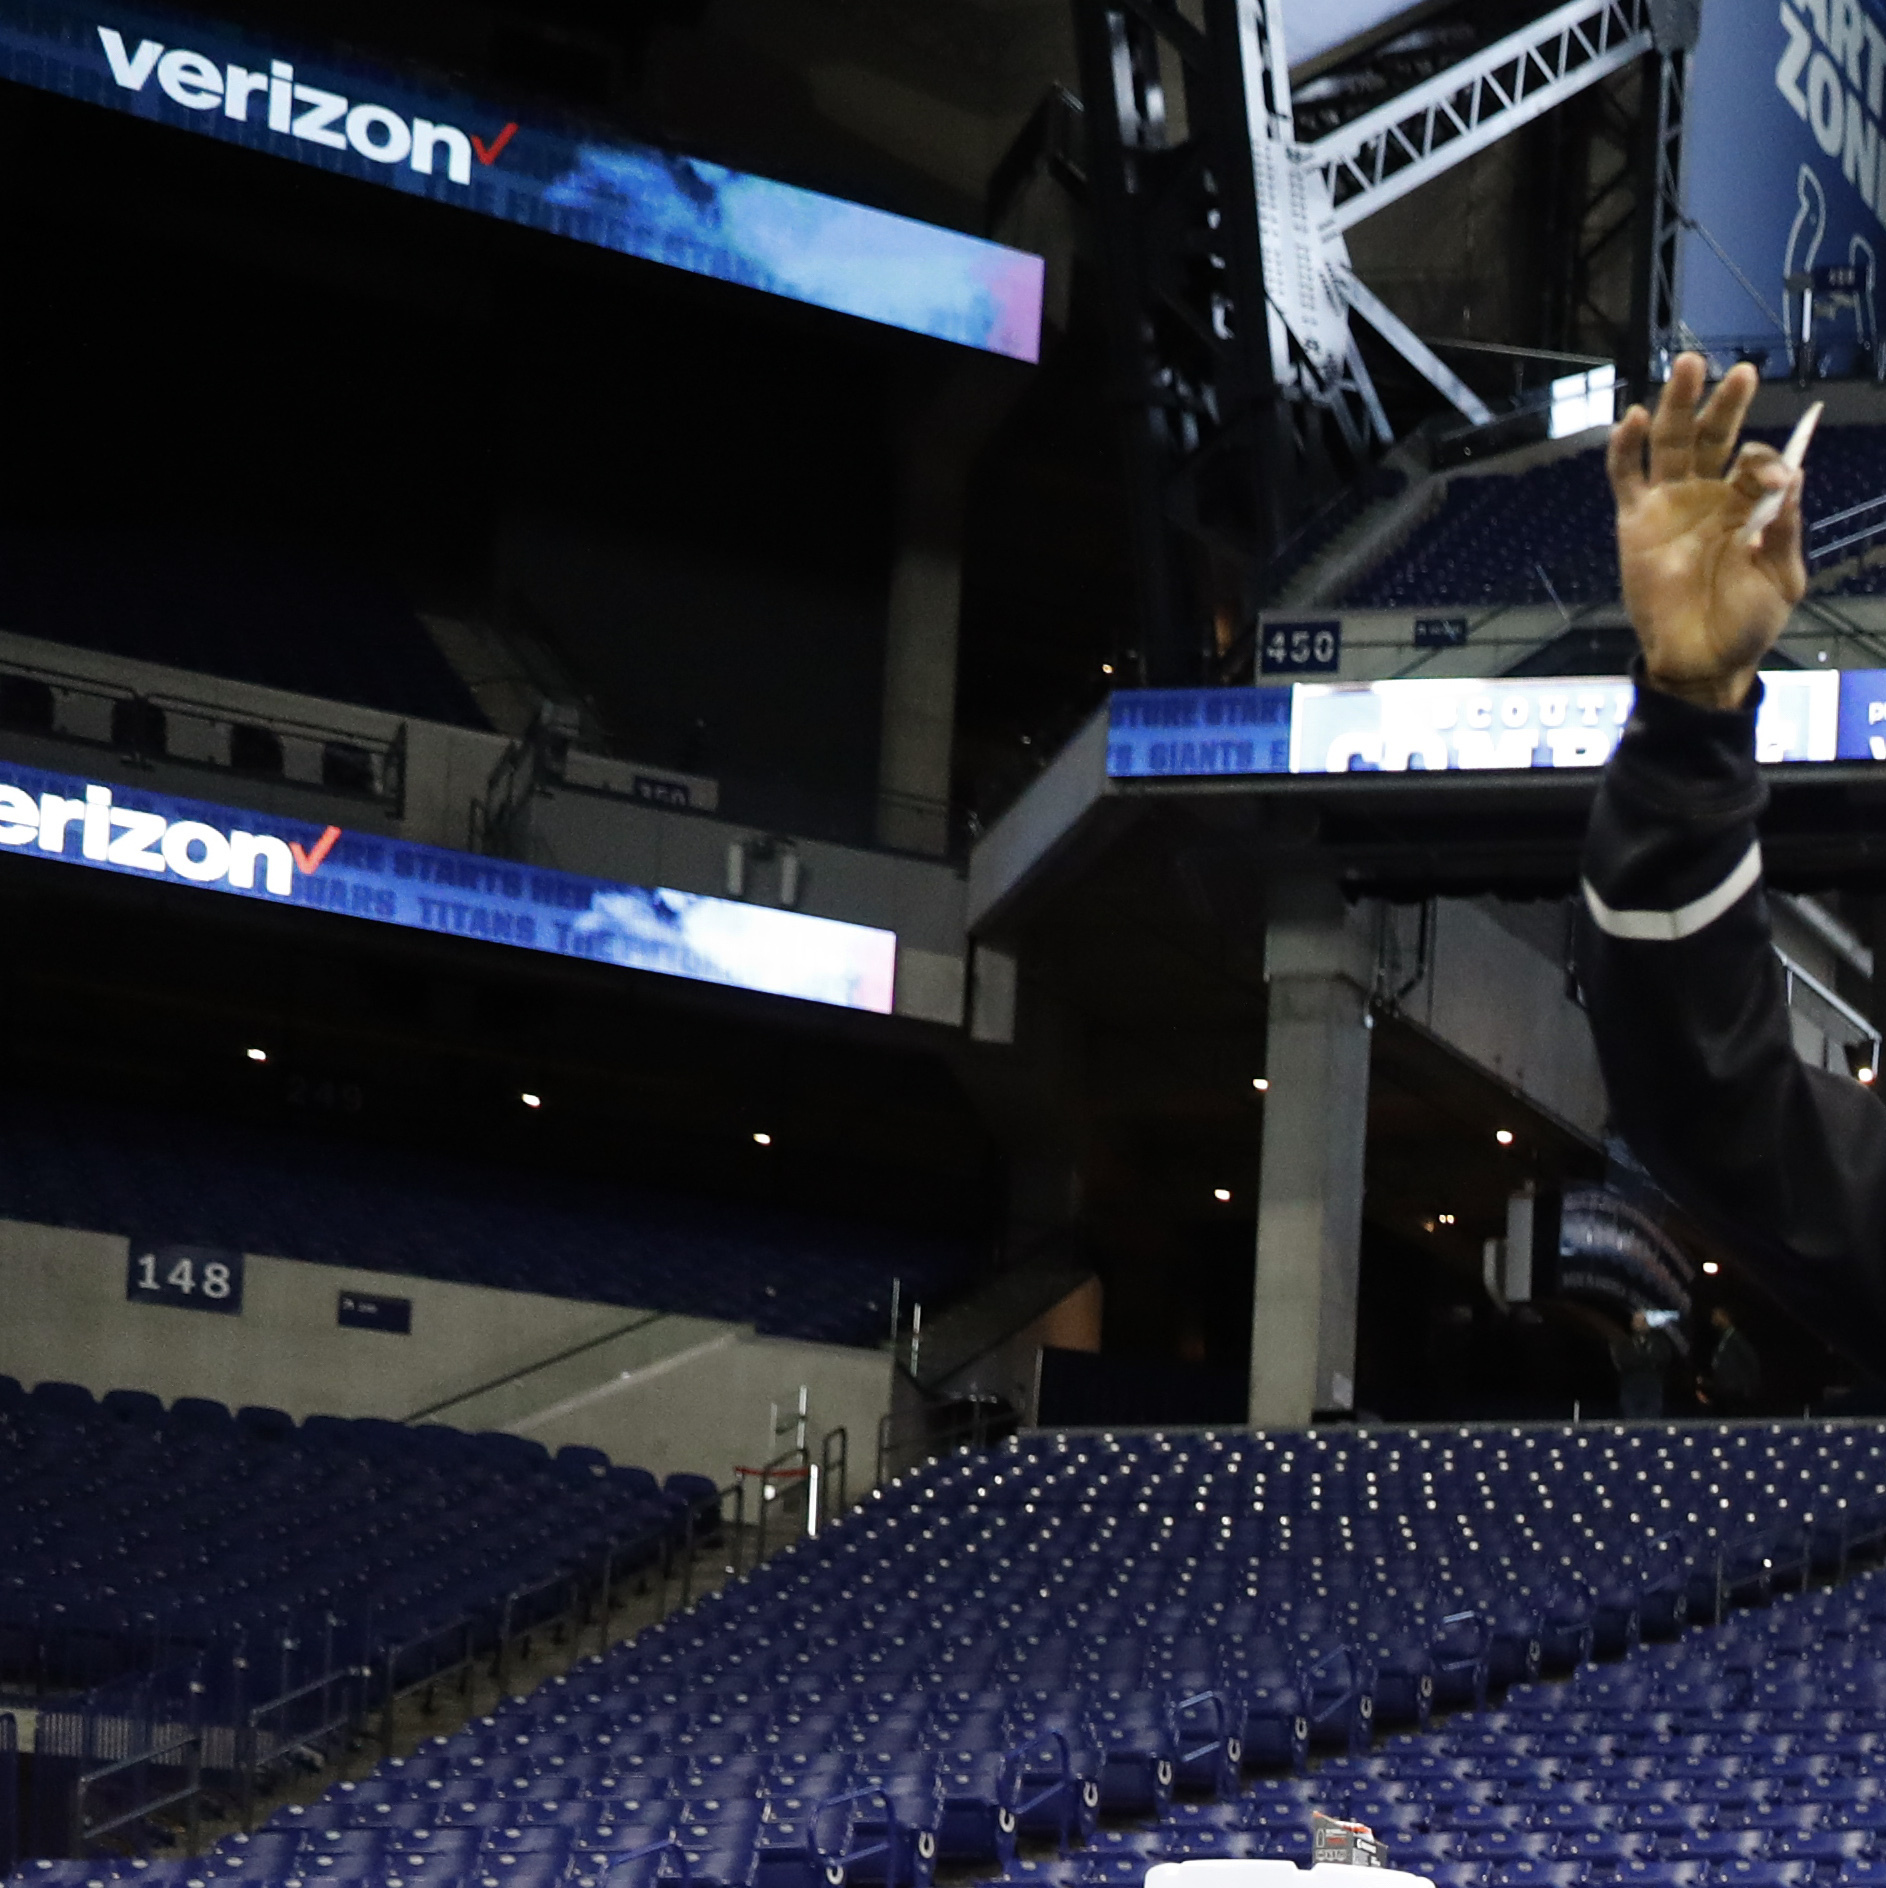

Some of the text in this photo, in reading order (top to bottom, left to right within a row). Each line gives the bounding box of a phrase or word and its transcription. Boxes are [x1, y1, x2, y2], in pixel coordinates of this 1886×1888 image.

[97, 26, 471, 185] verizon
[1265, 629, 1338, 664] 450
[0, 783, 294, 897] erizon
[136, 1253, 232, 1300] 148
